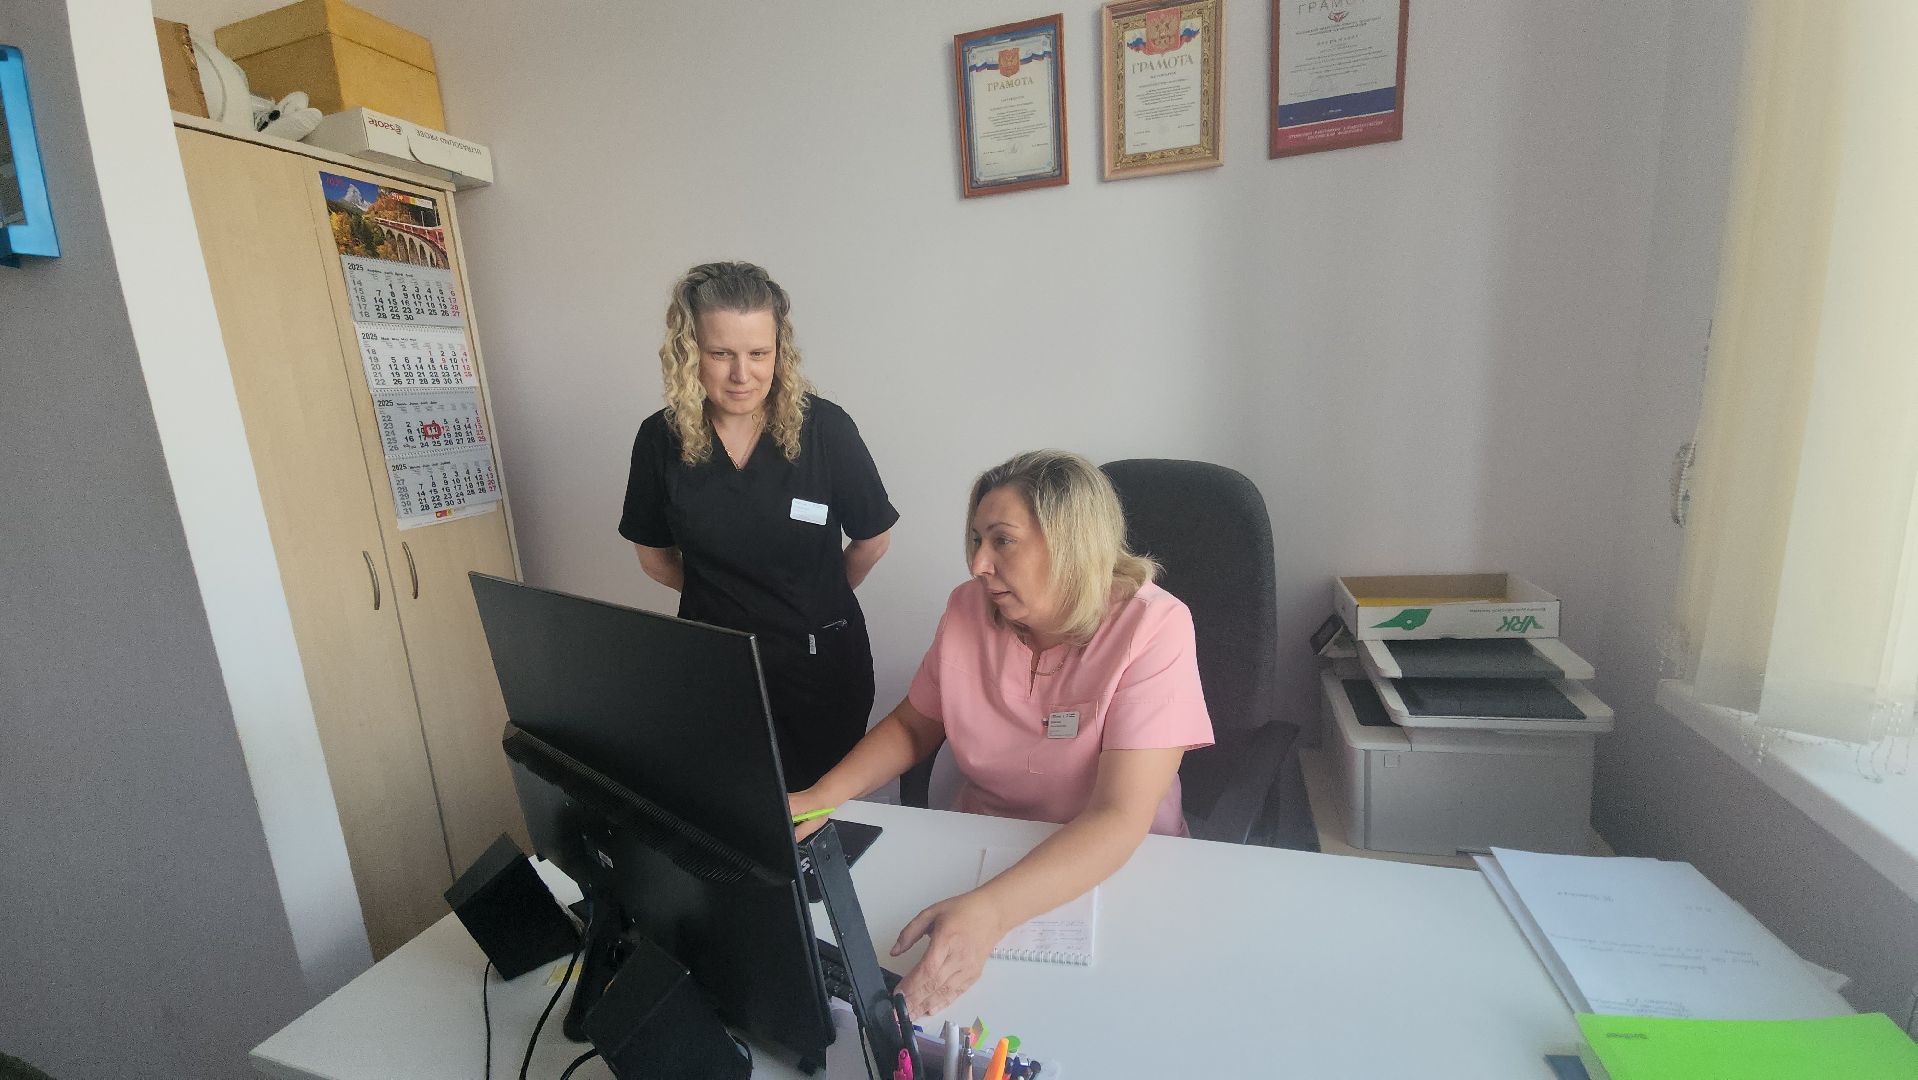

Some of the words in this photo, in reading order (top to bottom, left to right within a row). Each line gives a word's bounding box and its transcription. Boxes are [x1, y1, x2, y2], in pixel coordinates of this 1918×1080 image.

[1132, 54, 1194, 74] ГРАМОТА
[987, 76, 1034, 92] ГРАМОТА
[415, 129, 439, 142] PROBE
[348, 263, 363, 271] 2025
[1495, 616, 1545, 634] VRK
